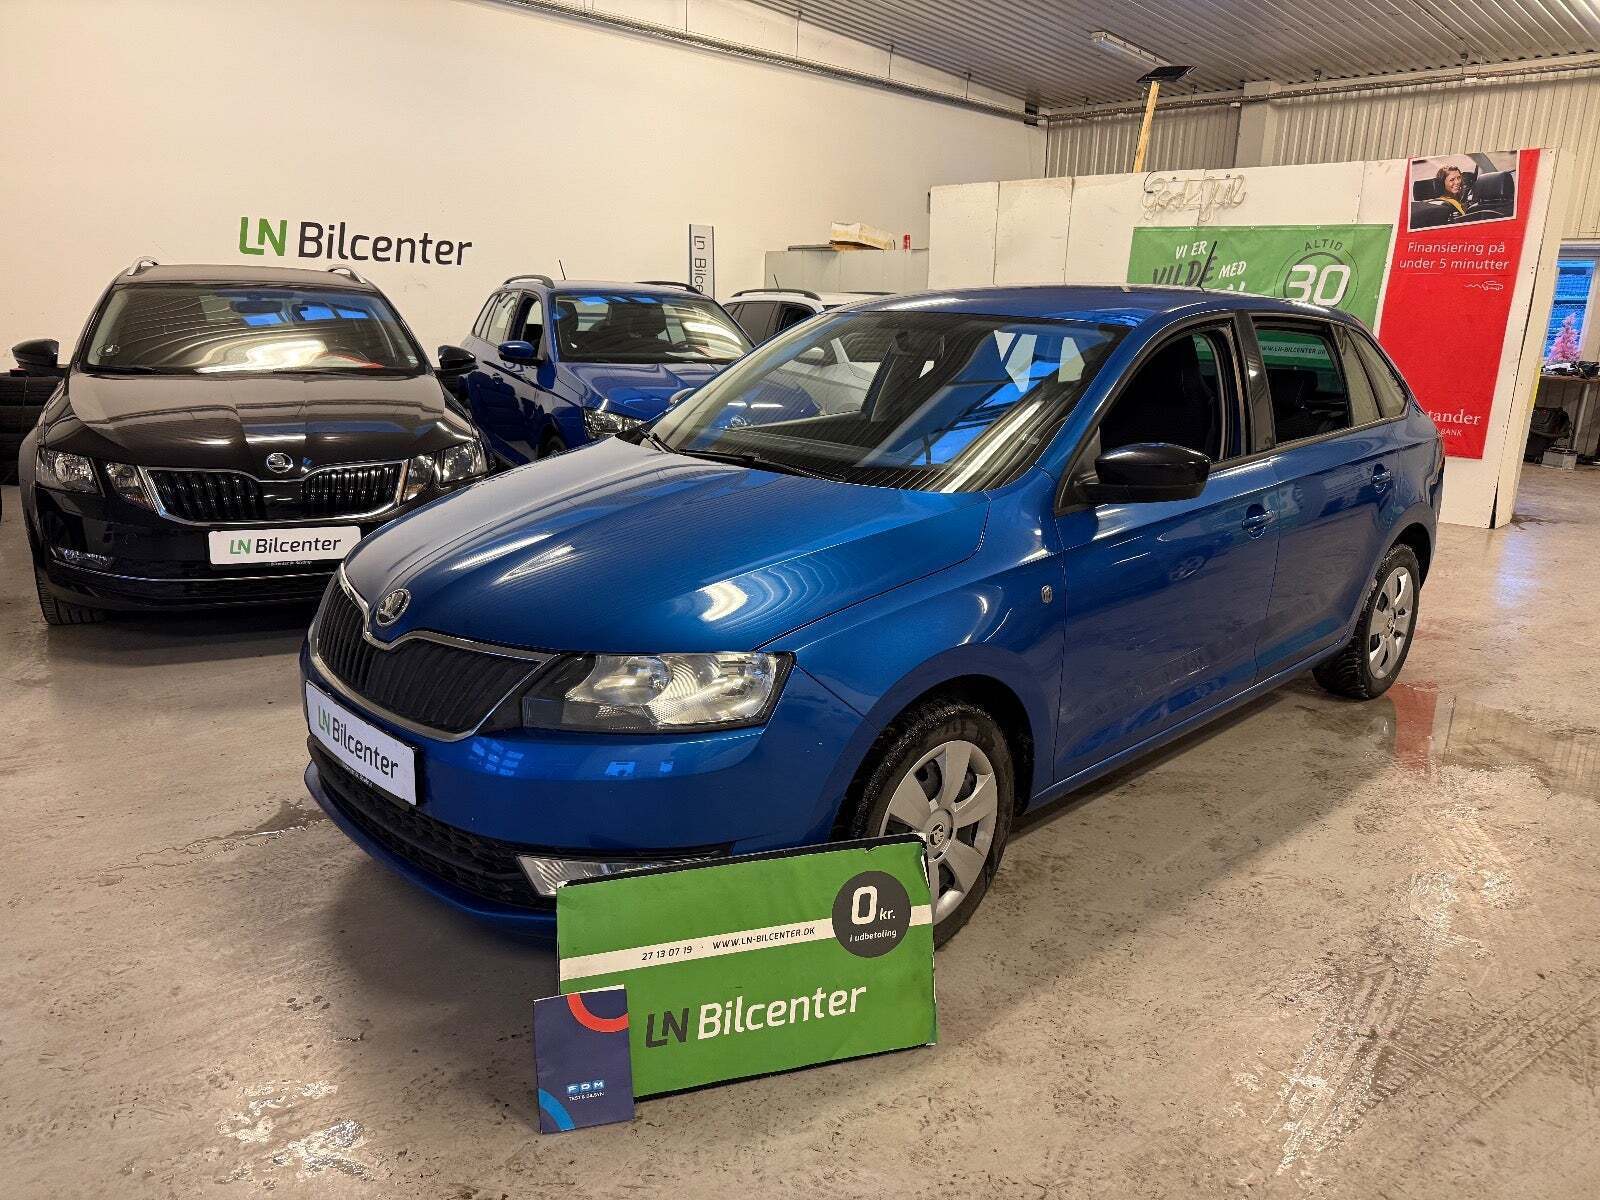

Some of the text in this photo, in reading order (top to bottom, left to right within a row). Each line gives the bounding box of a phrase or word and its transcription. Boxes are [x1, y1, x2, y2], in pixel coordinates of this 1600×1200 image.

[239, 216, 473, 266] LN Bilcenter
[1175, 240, 1208, 260] VI ER
[1304, 238, 1344, 252] ALTID
[1407, 241, 1506, 256] Finansiering på
[1218, 260, 1247, 279] MED
[1399, 257, 1510, 271] under 5 minutter
[694, 258, 707, 293] Bilce
[1287, 263, 1352, 307] 30
[1427, 407, 1482, 426] tander
[229, 536, 342, 555] LN Bilcenter
[317, 704, 331, 737] LN
[332, 716, 399, 779] Bilcenter
[851, 885, 896, 925] 0 kr.
[641, 926, 816, 962] 27 13 07 19 WWW.LN-BILCENTER.DK
[854, 929, 897, 942] udbetaling
[645, 985, 867, 1048] LN Bilcenter
